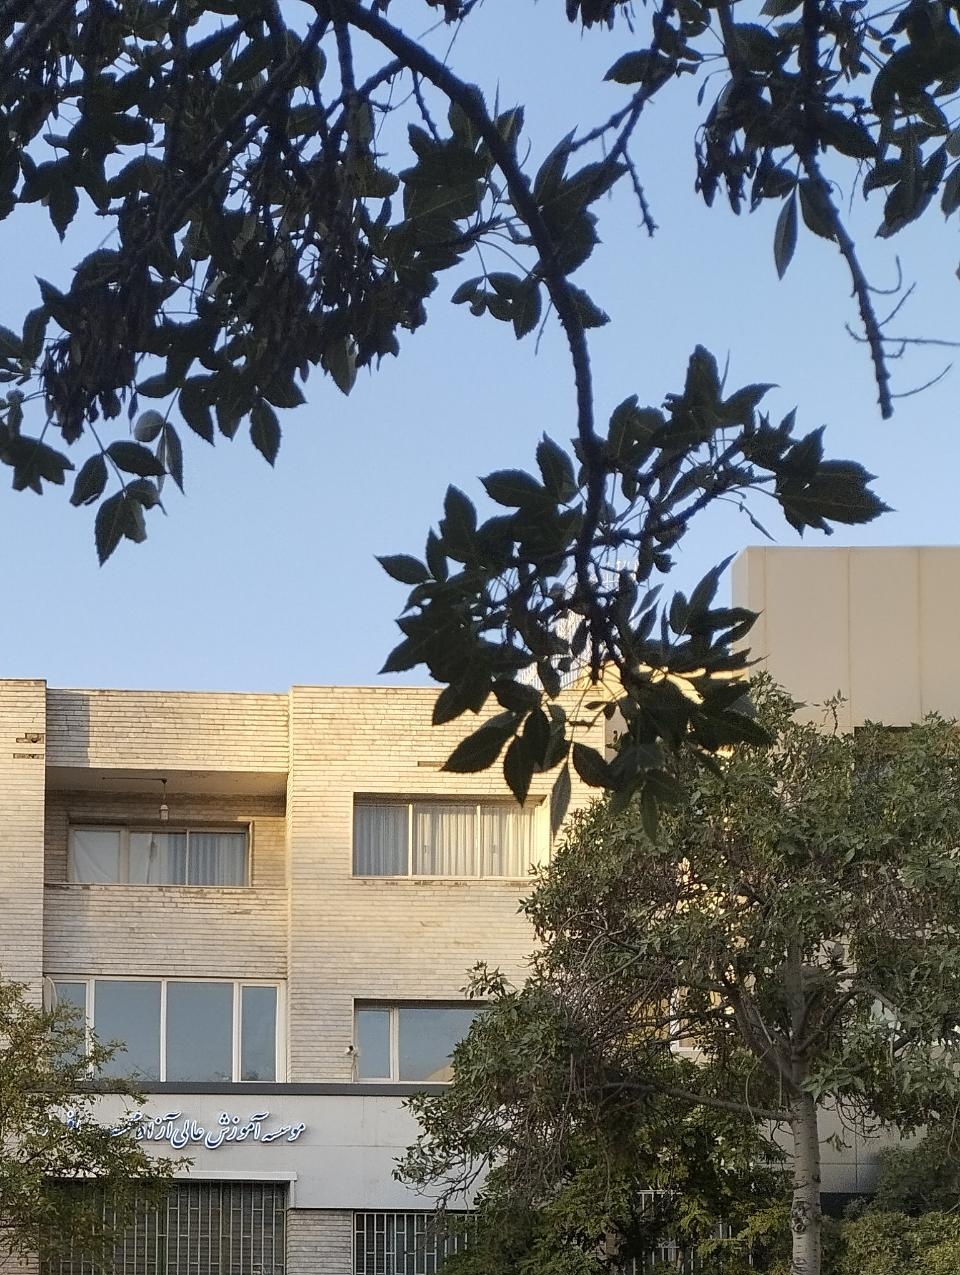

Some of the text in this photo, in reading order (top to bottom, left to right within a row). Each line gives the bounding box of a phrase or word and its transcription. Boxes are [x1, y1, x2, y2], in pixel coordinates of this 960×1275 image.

[170, 1120, 205, 1150] عالی
[204, 1111, 271, 1150] آموزش
[261, 1121, 306, 1143] موسسه
